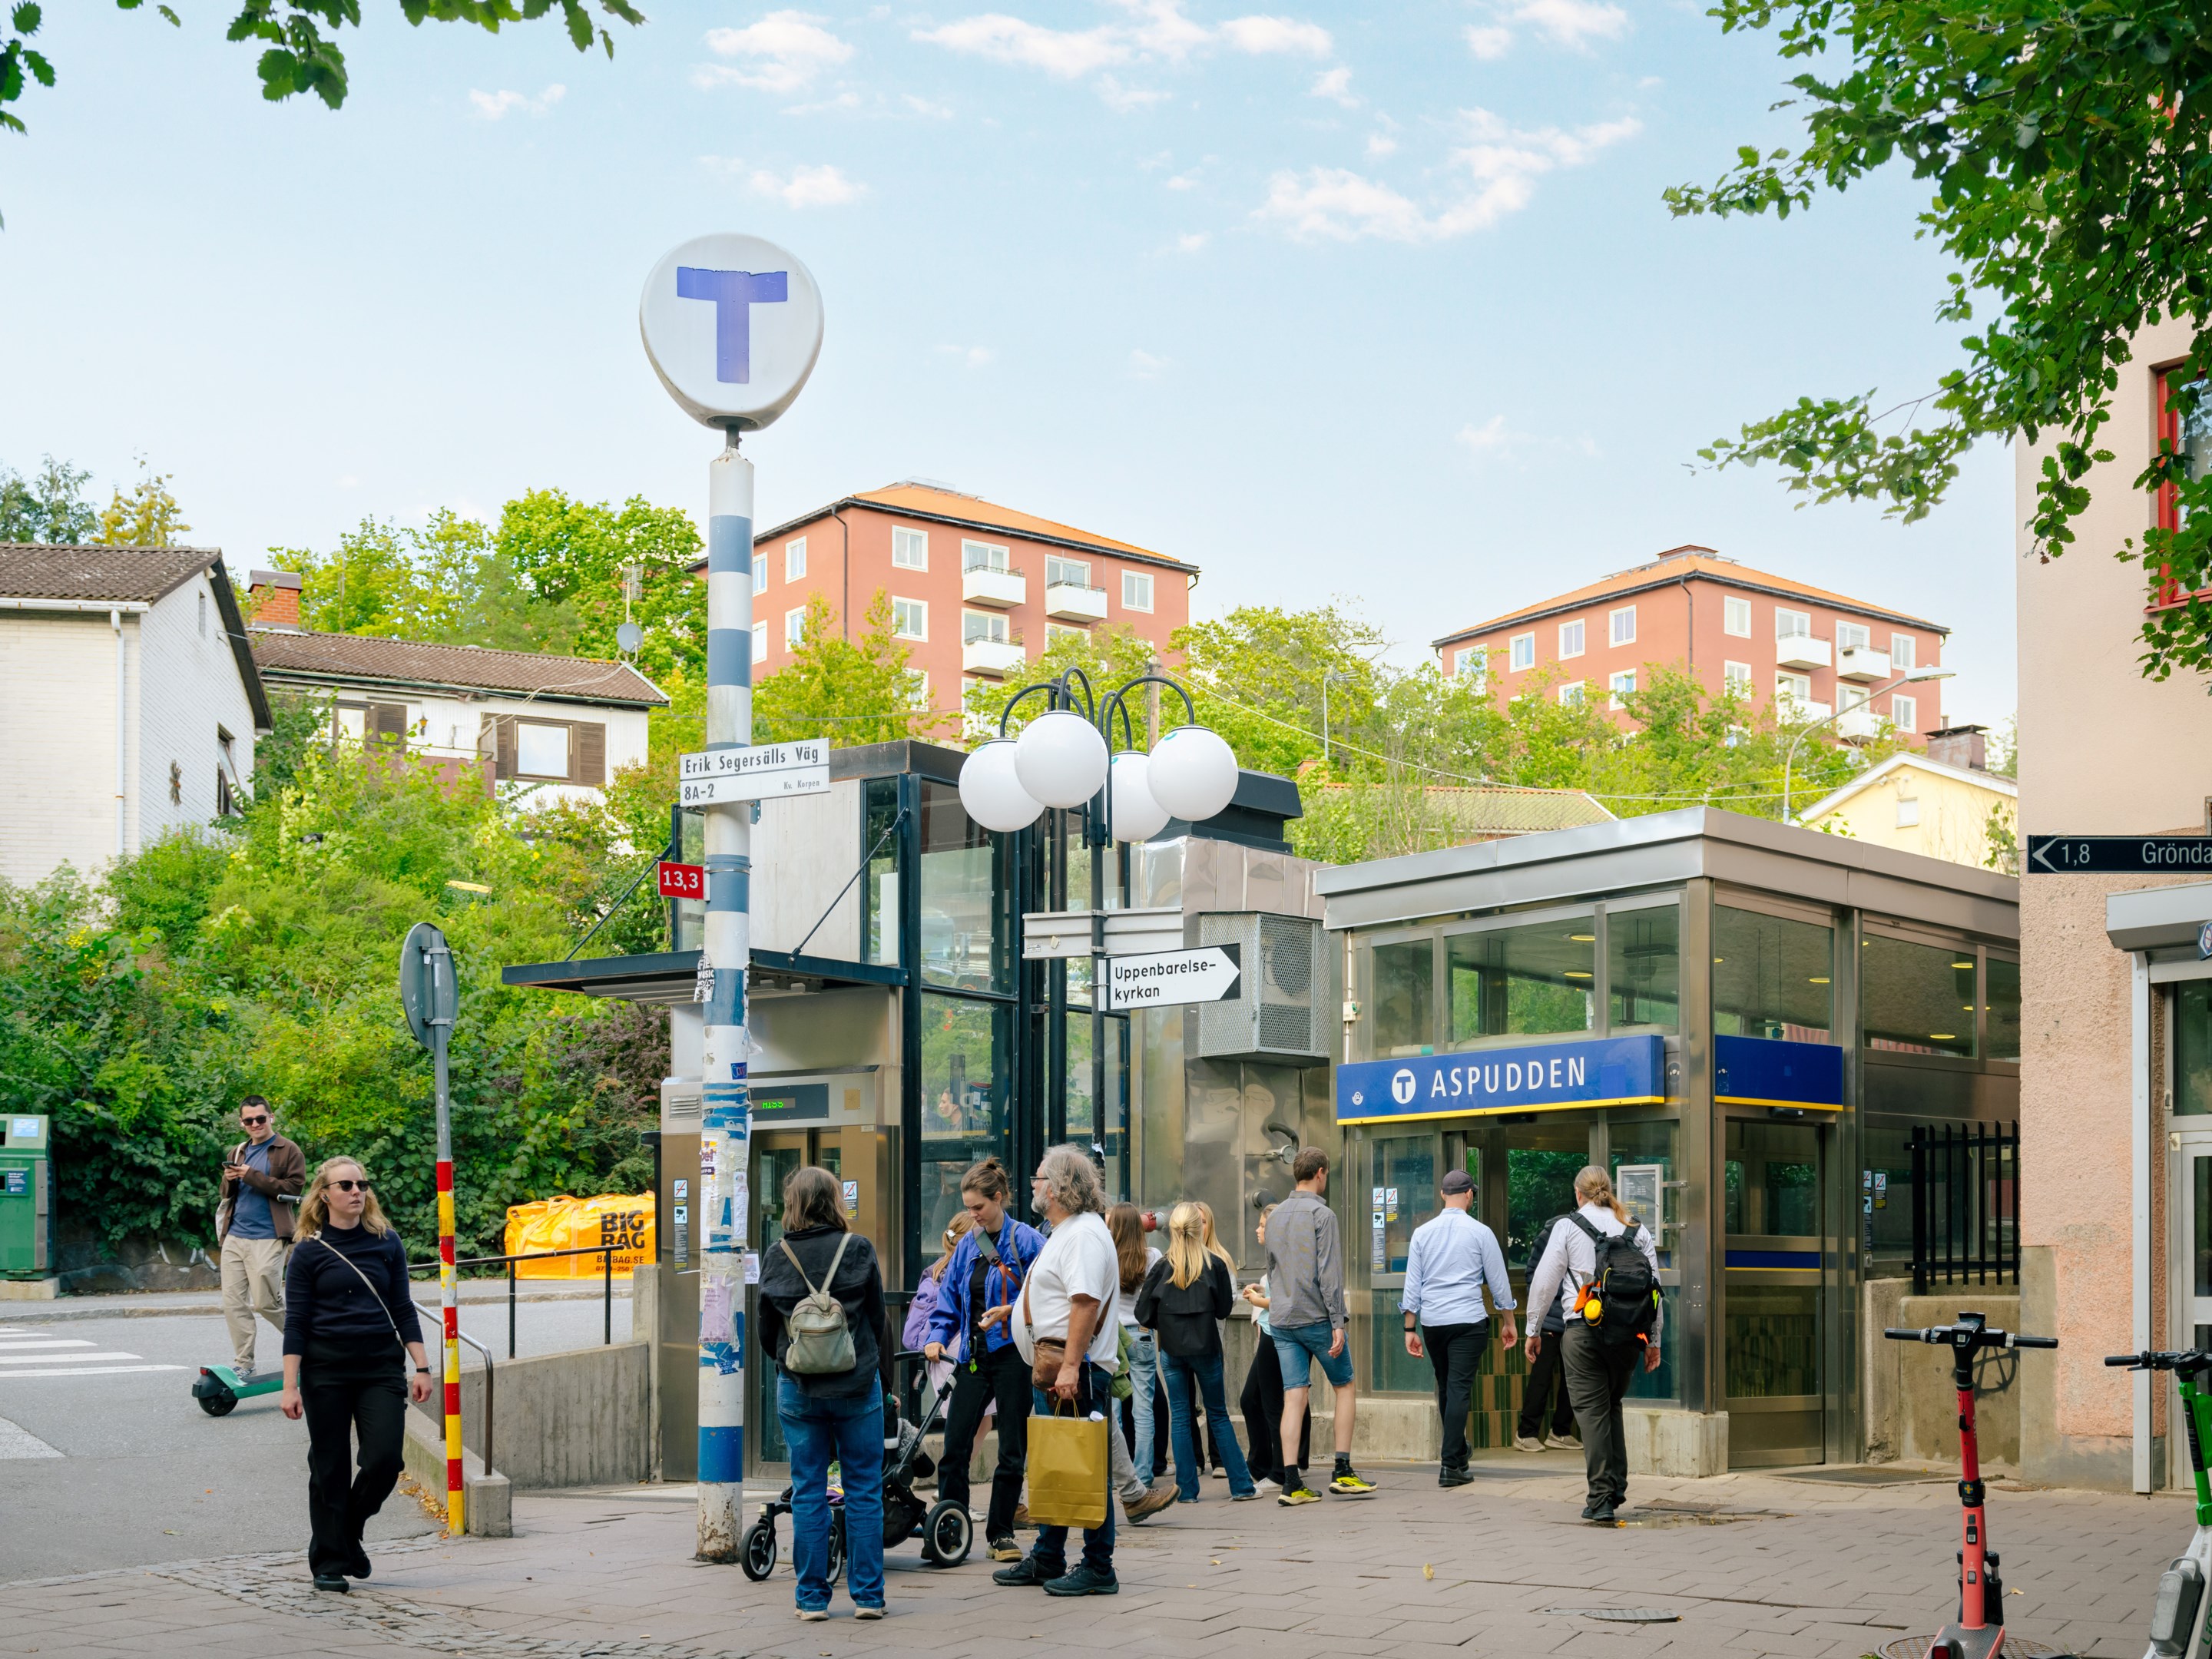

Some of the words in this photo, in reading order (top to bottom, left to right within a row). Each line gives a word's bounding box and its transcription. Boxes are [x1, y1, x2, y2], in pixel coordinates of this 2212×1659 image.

[677, 267, 788, 384] T
[685, 756, 711, 774] Erik
[719, 748, 786, 772] Segersälls
[795, 746, 819, 763] Väg
[684, 783, 715, 801] 8A-2
[783, 780, 793, 790] Kv.
[797, 780, 820, 790] Korpen
[2061, 843, 2091, 866] 1,8
[662, 869, 699, 892] 13,3
[1115, 960, 1216, 982] Uppenbarelse-
[1114, 986, 1161, 1003] kyrkan
[1431, 1056, 1585, 1098] ASPUDDEN
[601, 1210, 644, 1233] BIG
[601, 1231, 645, 1250] BAG
